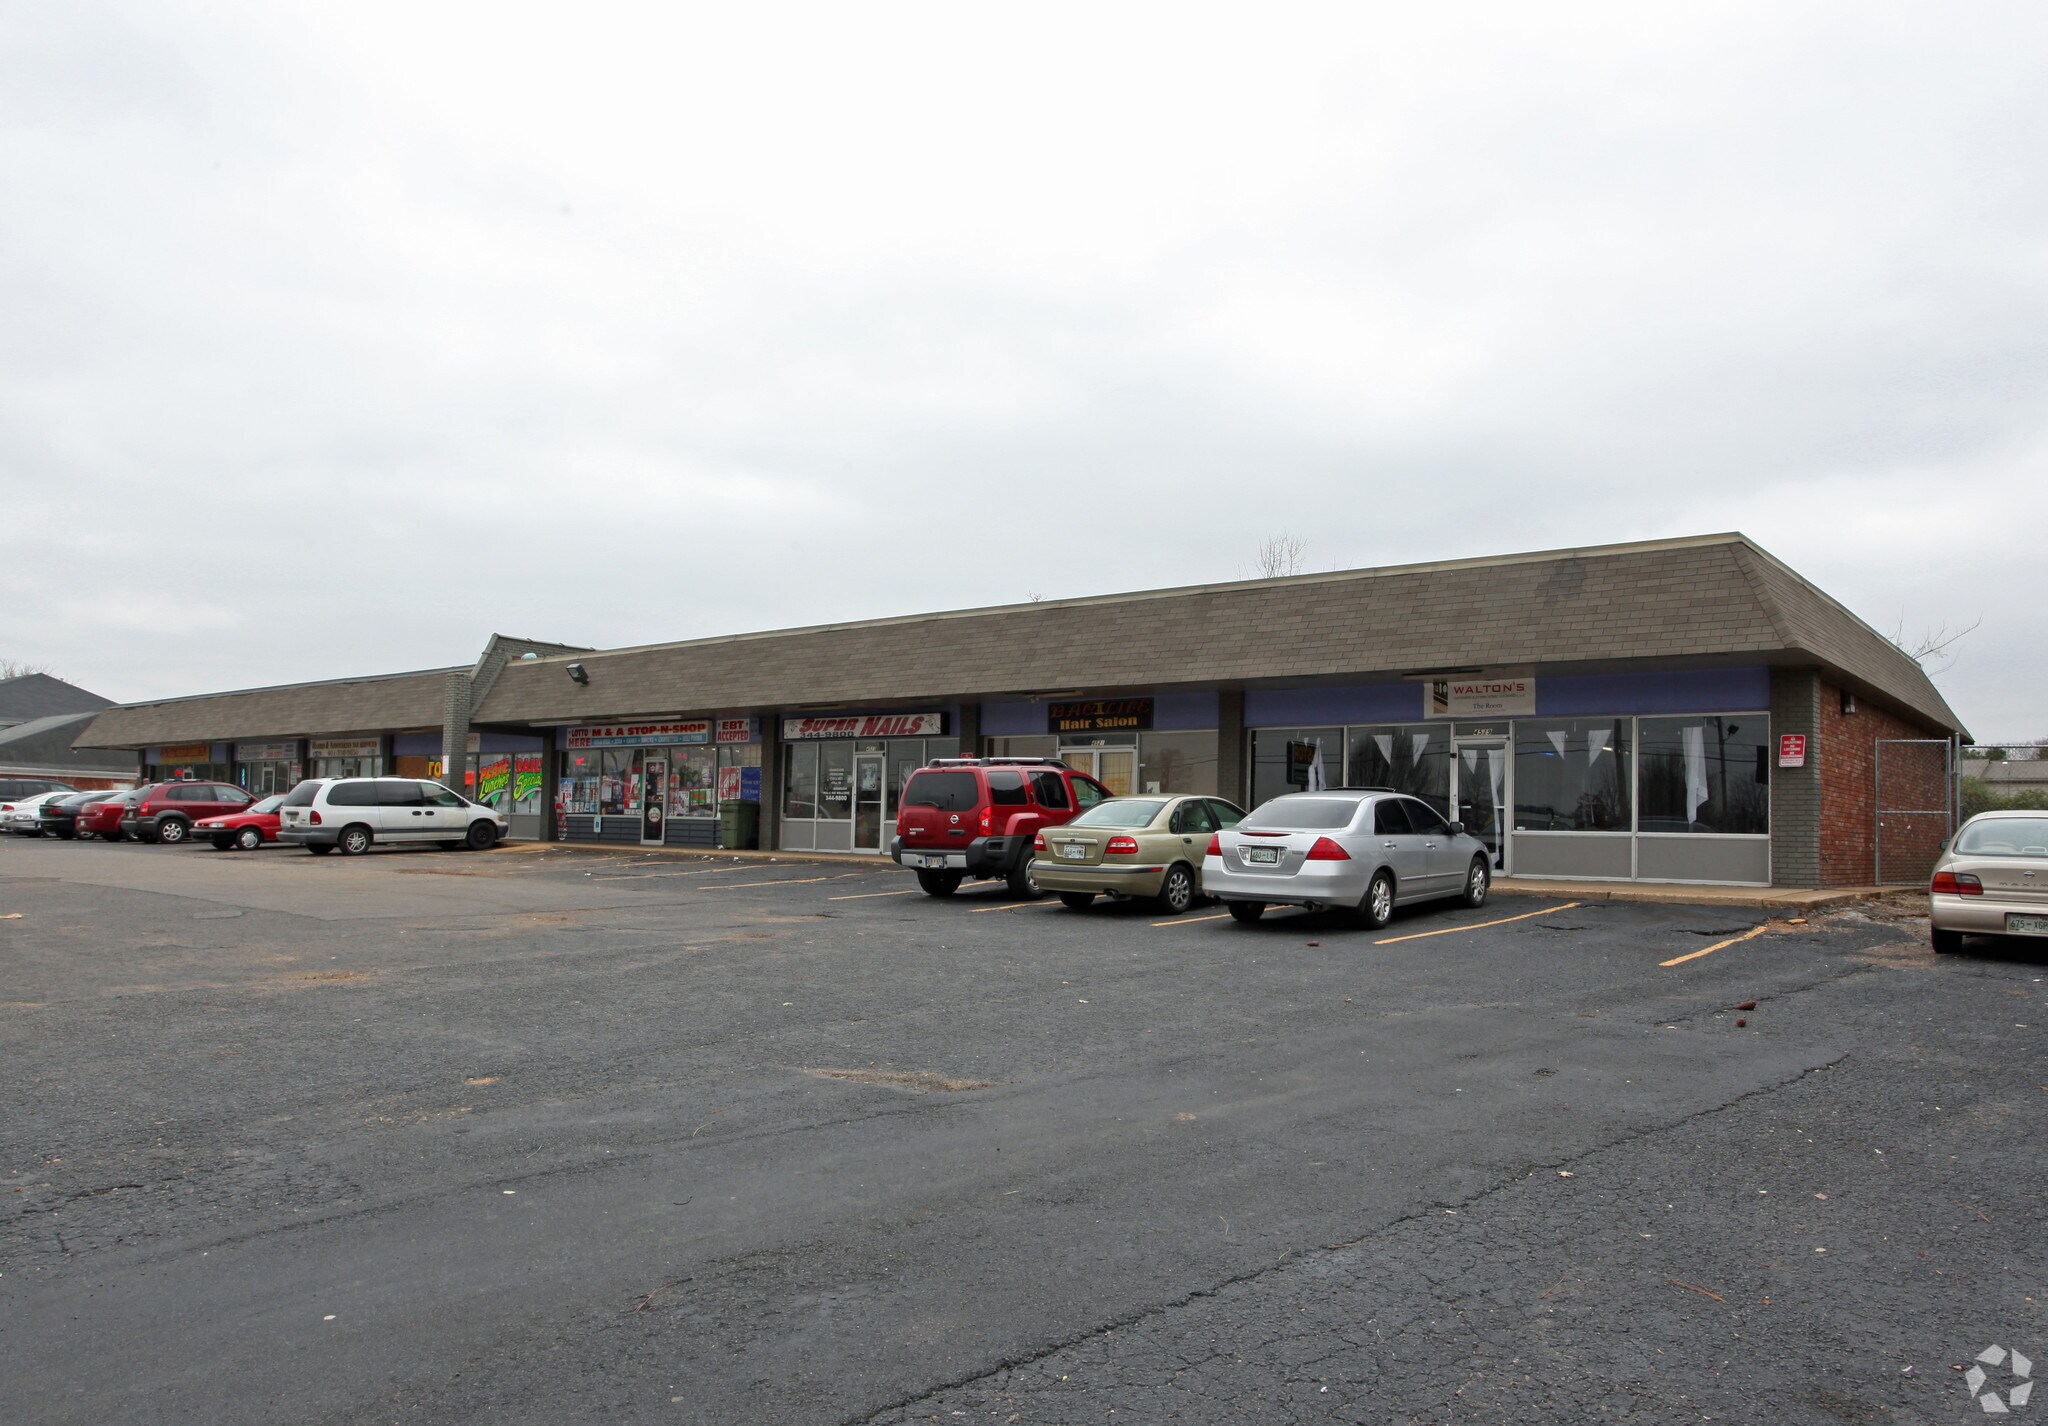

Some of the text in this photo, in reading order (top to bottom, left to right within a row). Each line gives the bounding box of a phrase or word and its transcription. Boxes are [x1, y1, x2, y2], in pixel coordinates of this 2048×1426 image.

[1454, 682, 1525, 694] WALTON'S
[722, 721, 745, 730] EBT
[799, 716, 925, 736] SUPER NAILS
[1060, 716, 1138, 730] Hair Salon
[571, 728, 589, 737] LOTTO
[592, 723, 706, 737] M & A STOP-N-SHOP
[717, 730, 749, 742] ACCEPTED
[568, 738, 591, 747] HERE
[479, 758, 510, 783] PLATE
[479, 773, 511, 800] Lunches
